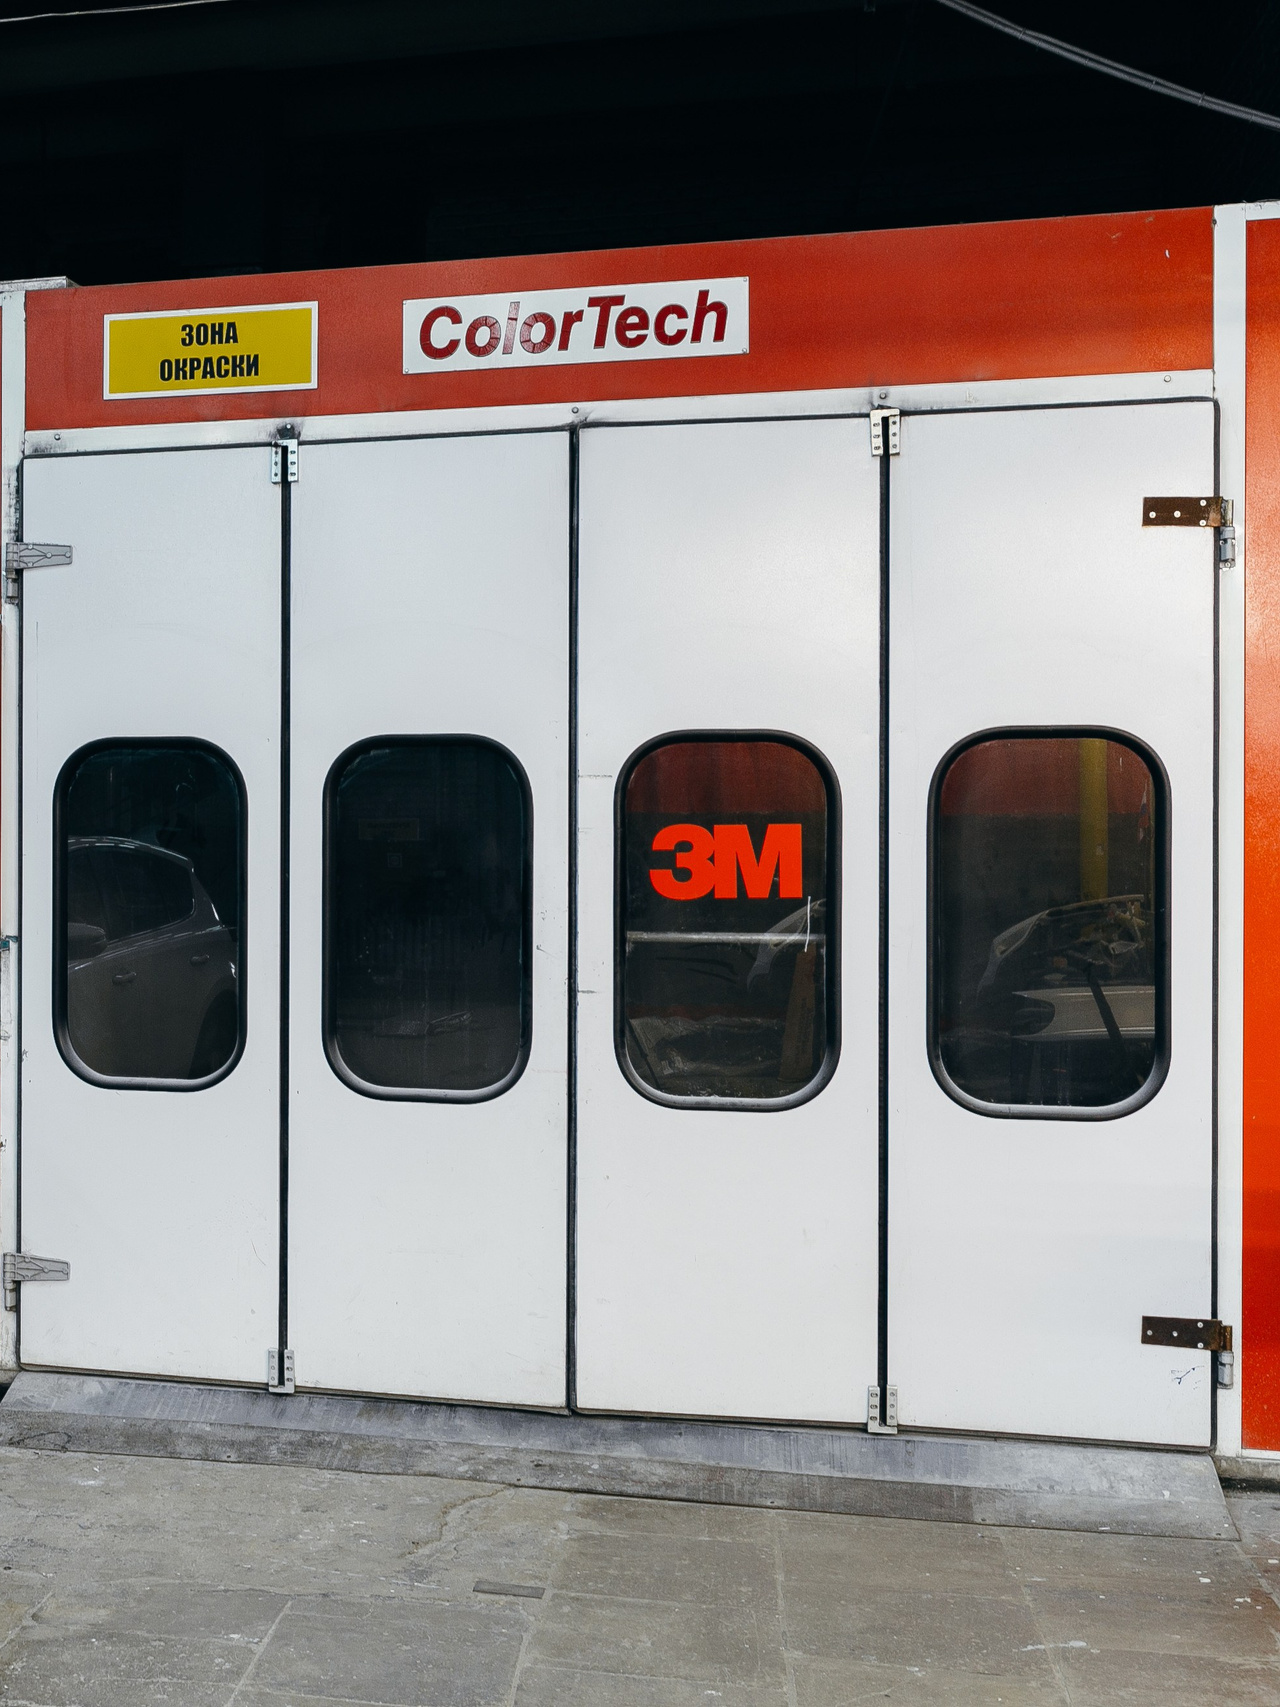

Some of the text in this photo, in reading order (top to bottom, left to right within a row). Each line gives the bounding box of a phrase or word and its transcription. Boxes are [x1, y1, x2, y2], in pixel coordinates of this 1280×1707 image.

[180, 321, 239, 348] ЗОНА
[419, 289, 728, 361] ColorTech
[158, 353, 260, 382] ОКРАСКИ
[649, 823, 803, 900] 3M
